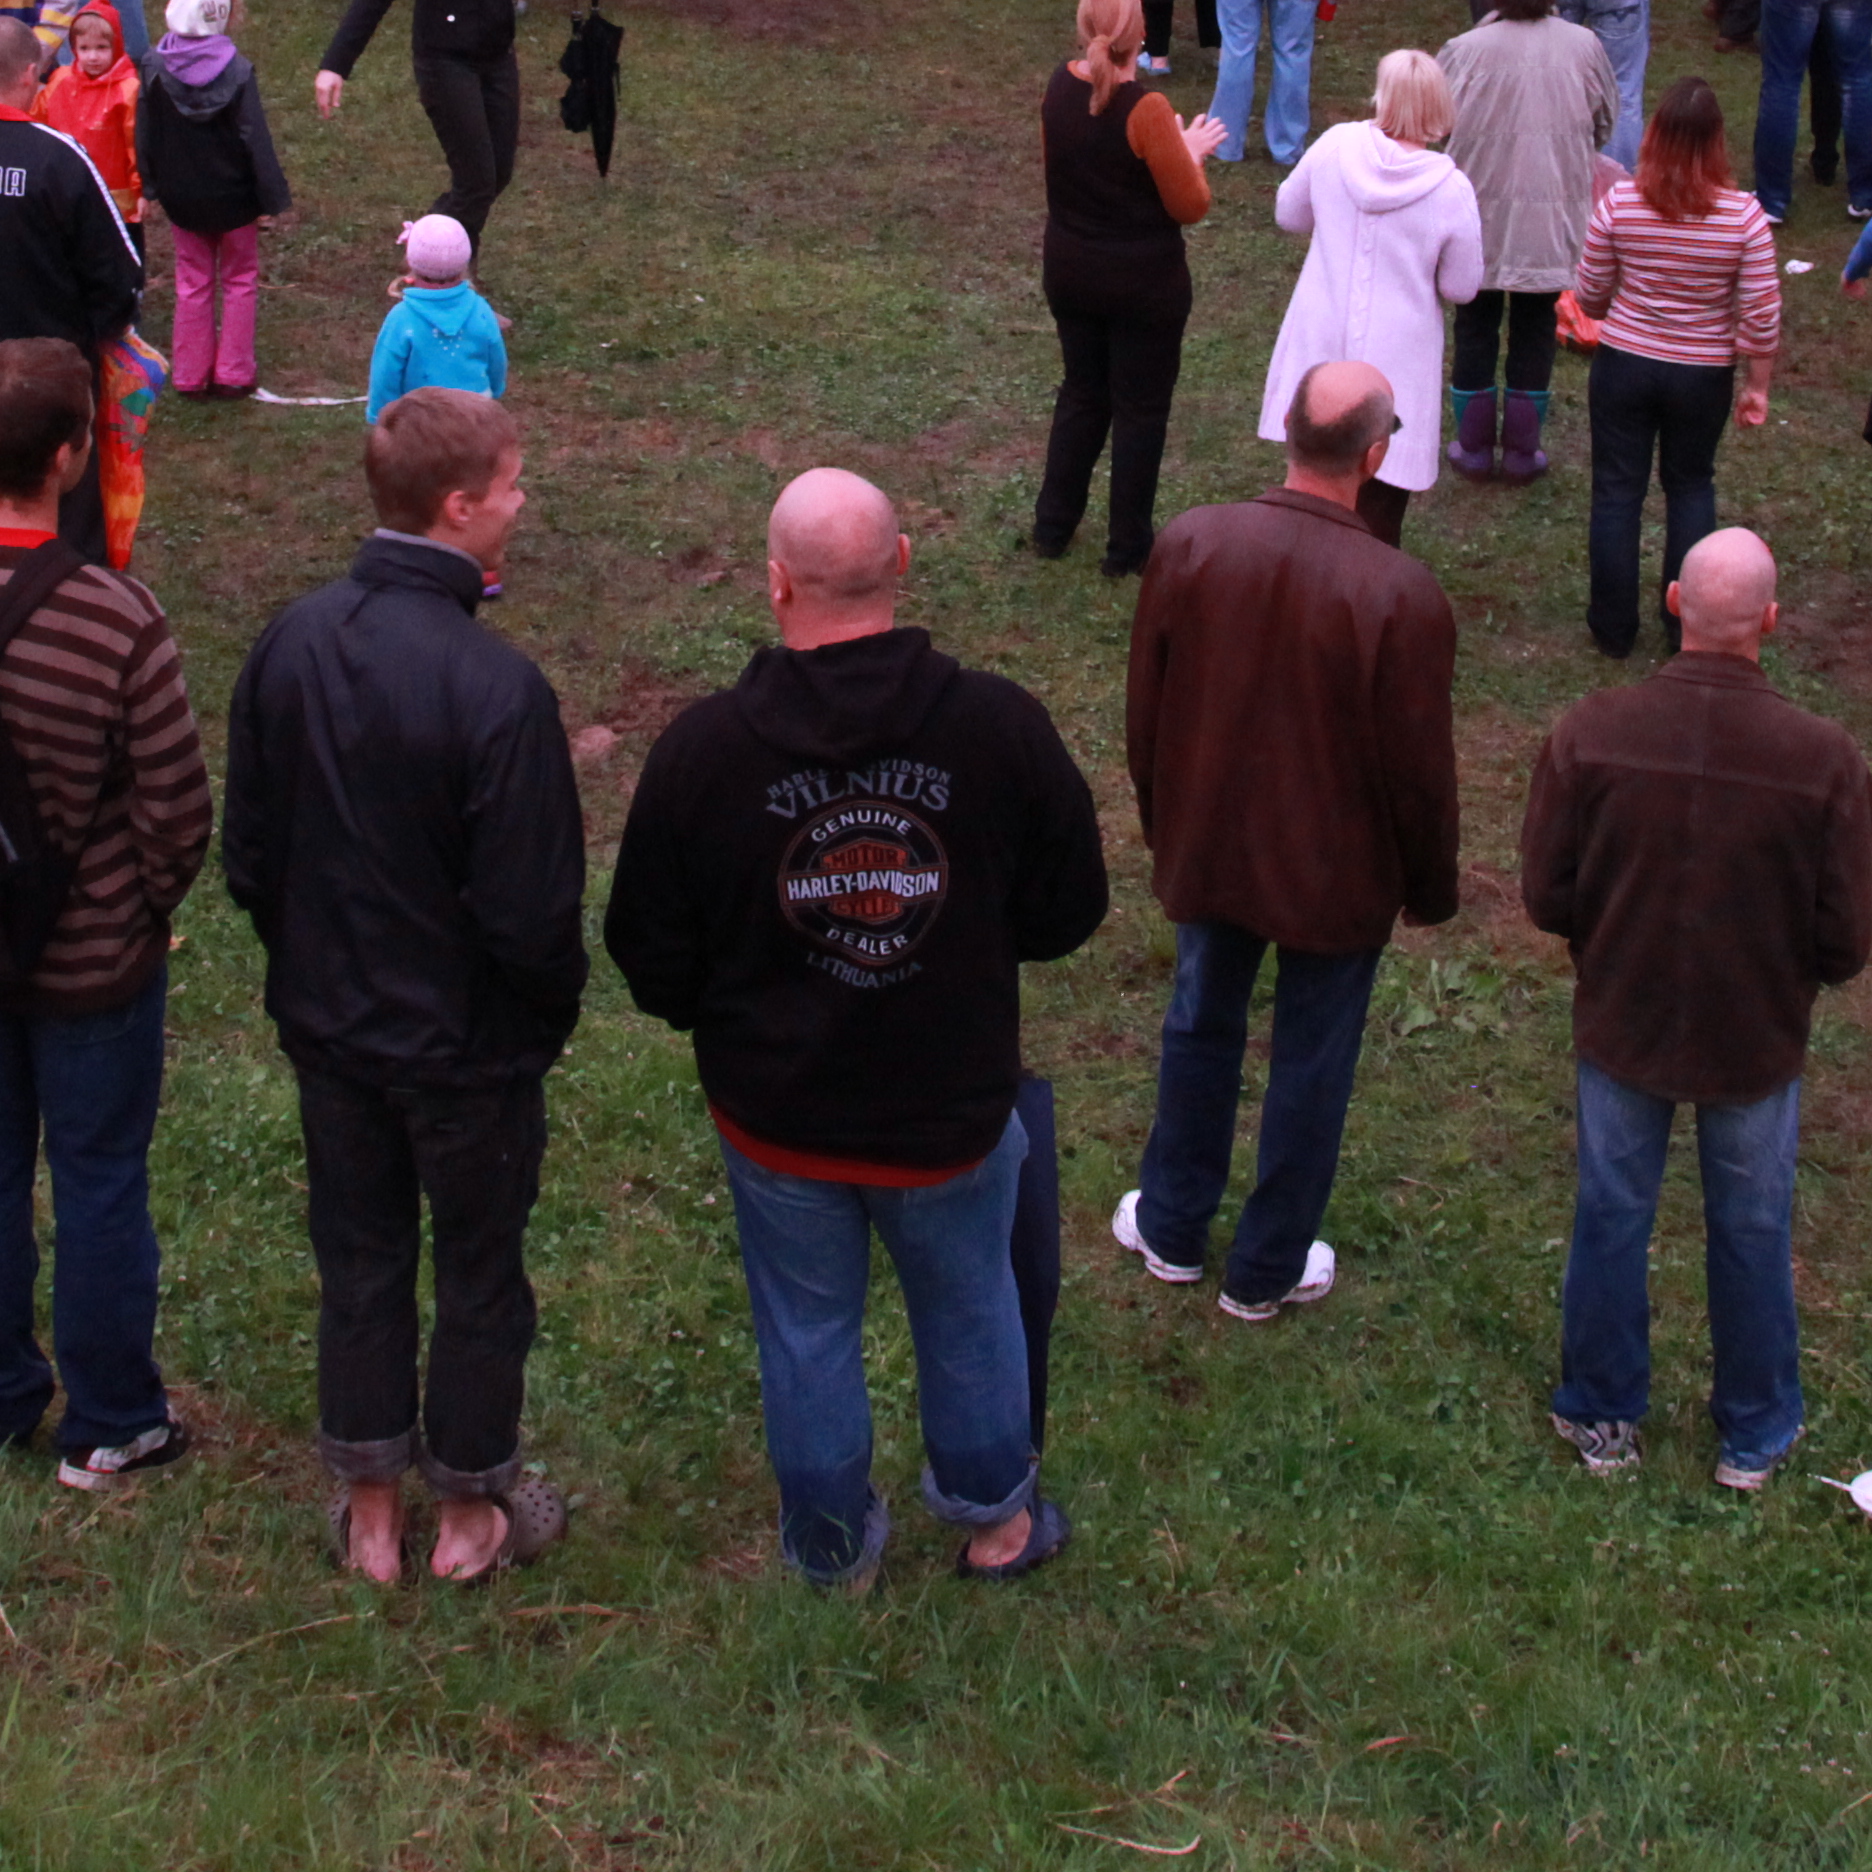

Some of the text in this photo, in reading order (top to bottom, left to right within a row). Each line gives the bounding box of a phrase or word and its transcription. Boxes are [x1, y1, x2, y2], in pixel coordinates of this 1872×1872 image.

[766, 770, 951, 820] VILNIUS
[810, 809, 912, 843] GENUINE
[786, 869, 940, 901] HARLEY-DAVIDSON
[825, 927, 910, 956] DEALER
[806, 951, 923, 989] LITHUANIA
